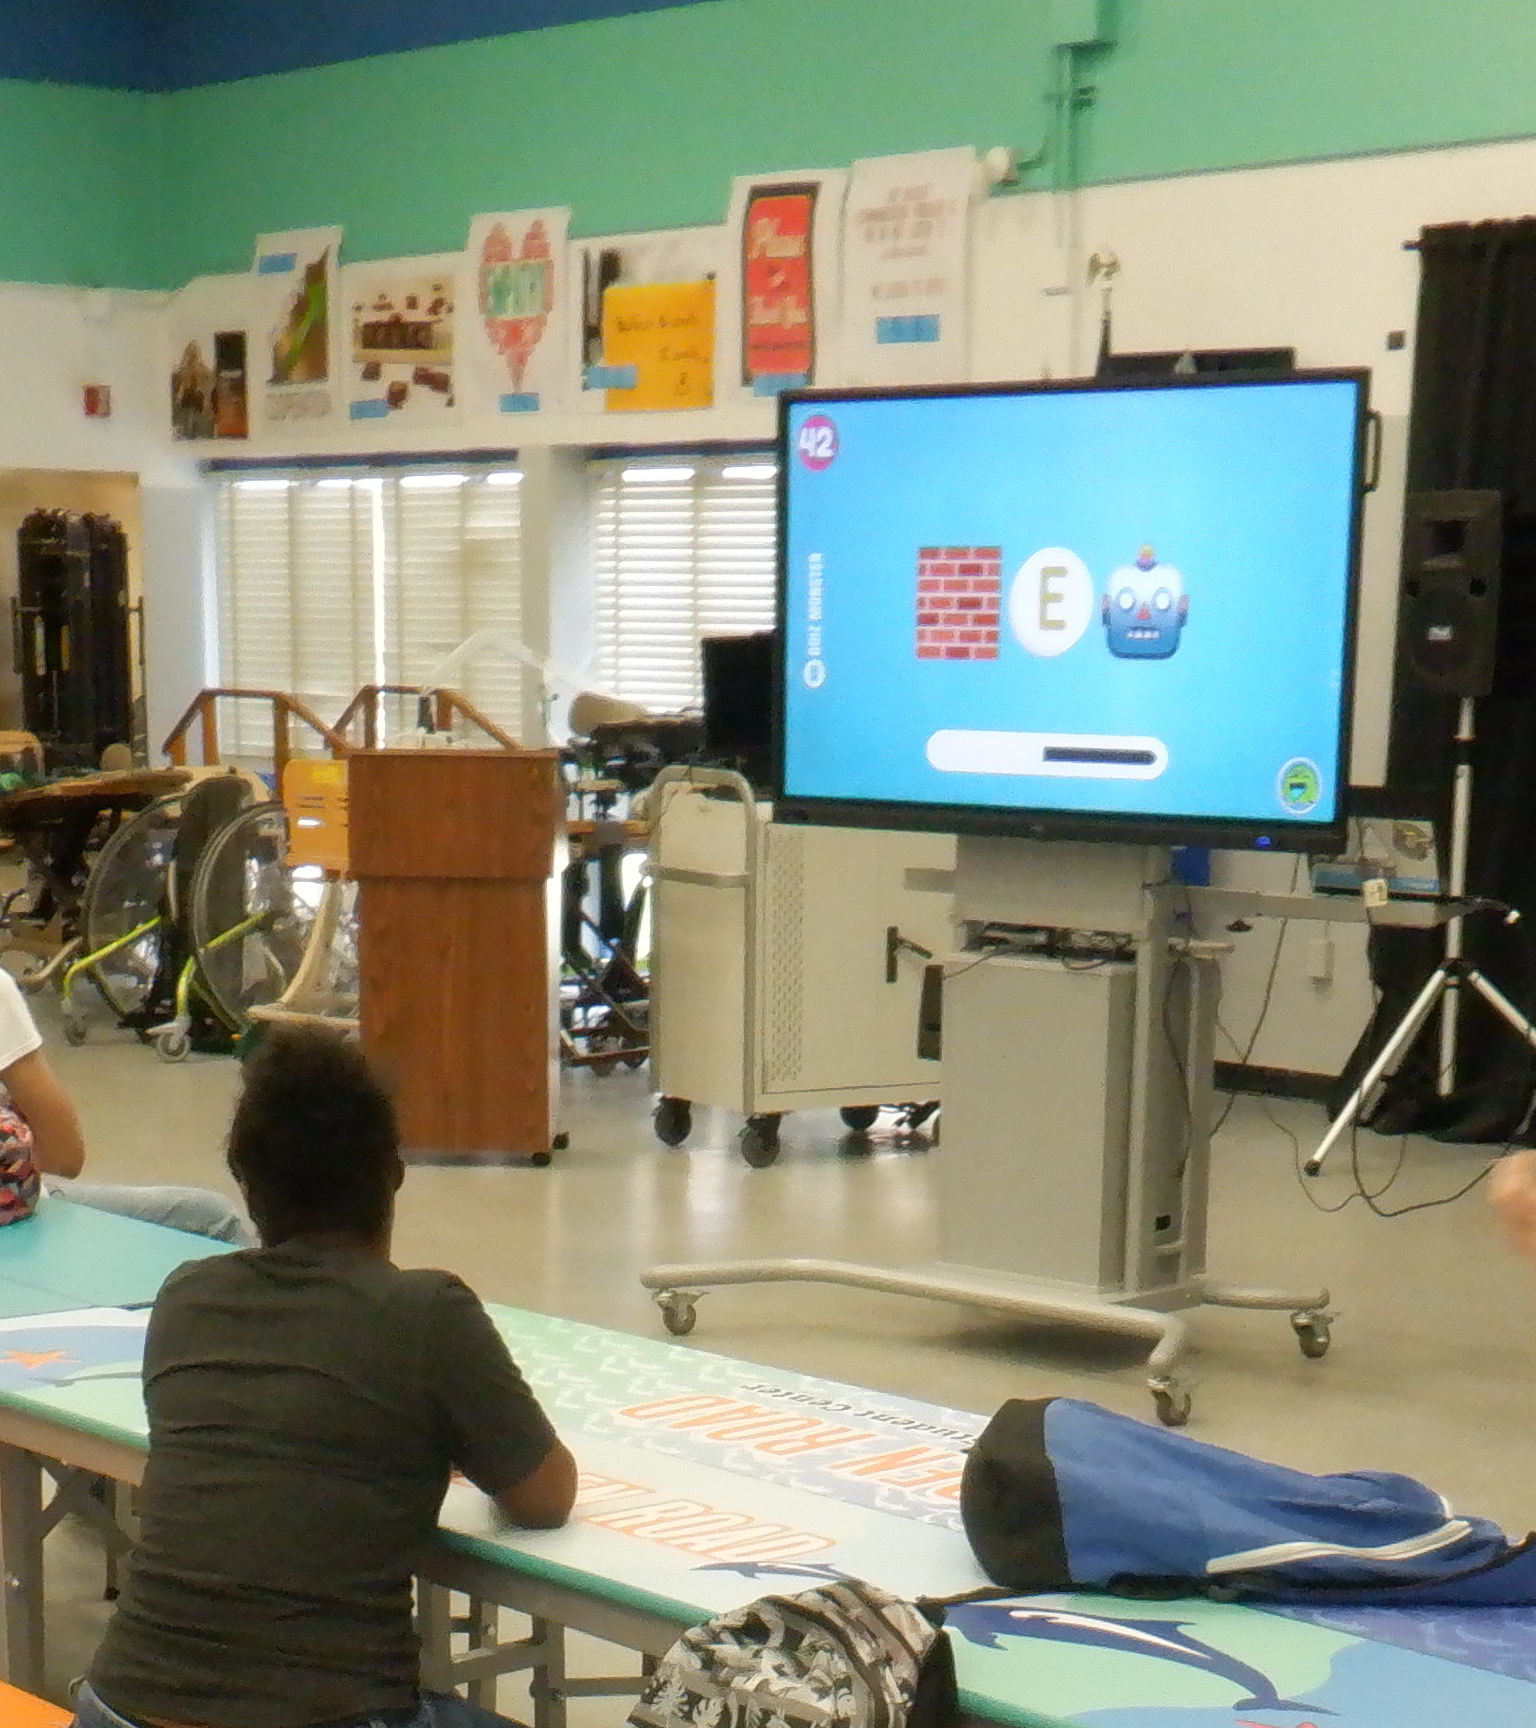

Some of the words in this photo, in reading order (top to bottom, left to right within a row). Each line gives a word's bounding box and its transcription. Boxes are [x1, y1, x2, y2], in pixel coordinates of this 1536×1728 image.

[799, 426, 834, 458] 42
[1039, 567, 1068, 630] E
[618, 1395, 877, 1456] ROAD
[742, 1384, 852, 1412] Center
[579, 1498, 837, 1562] ROAD
